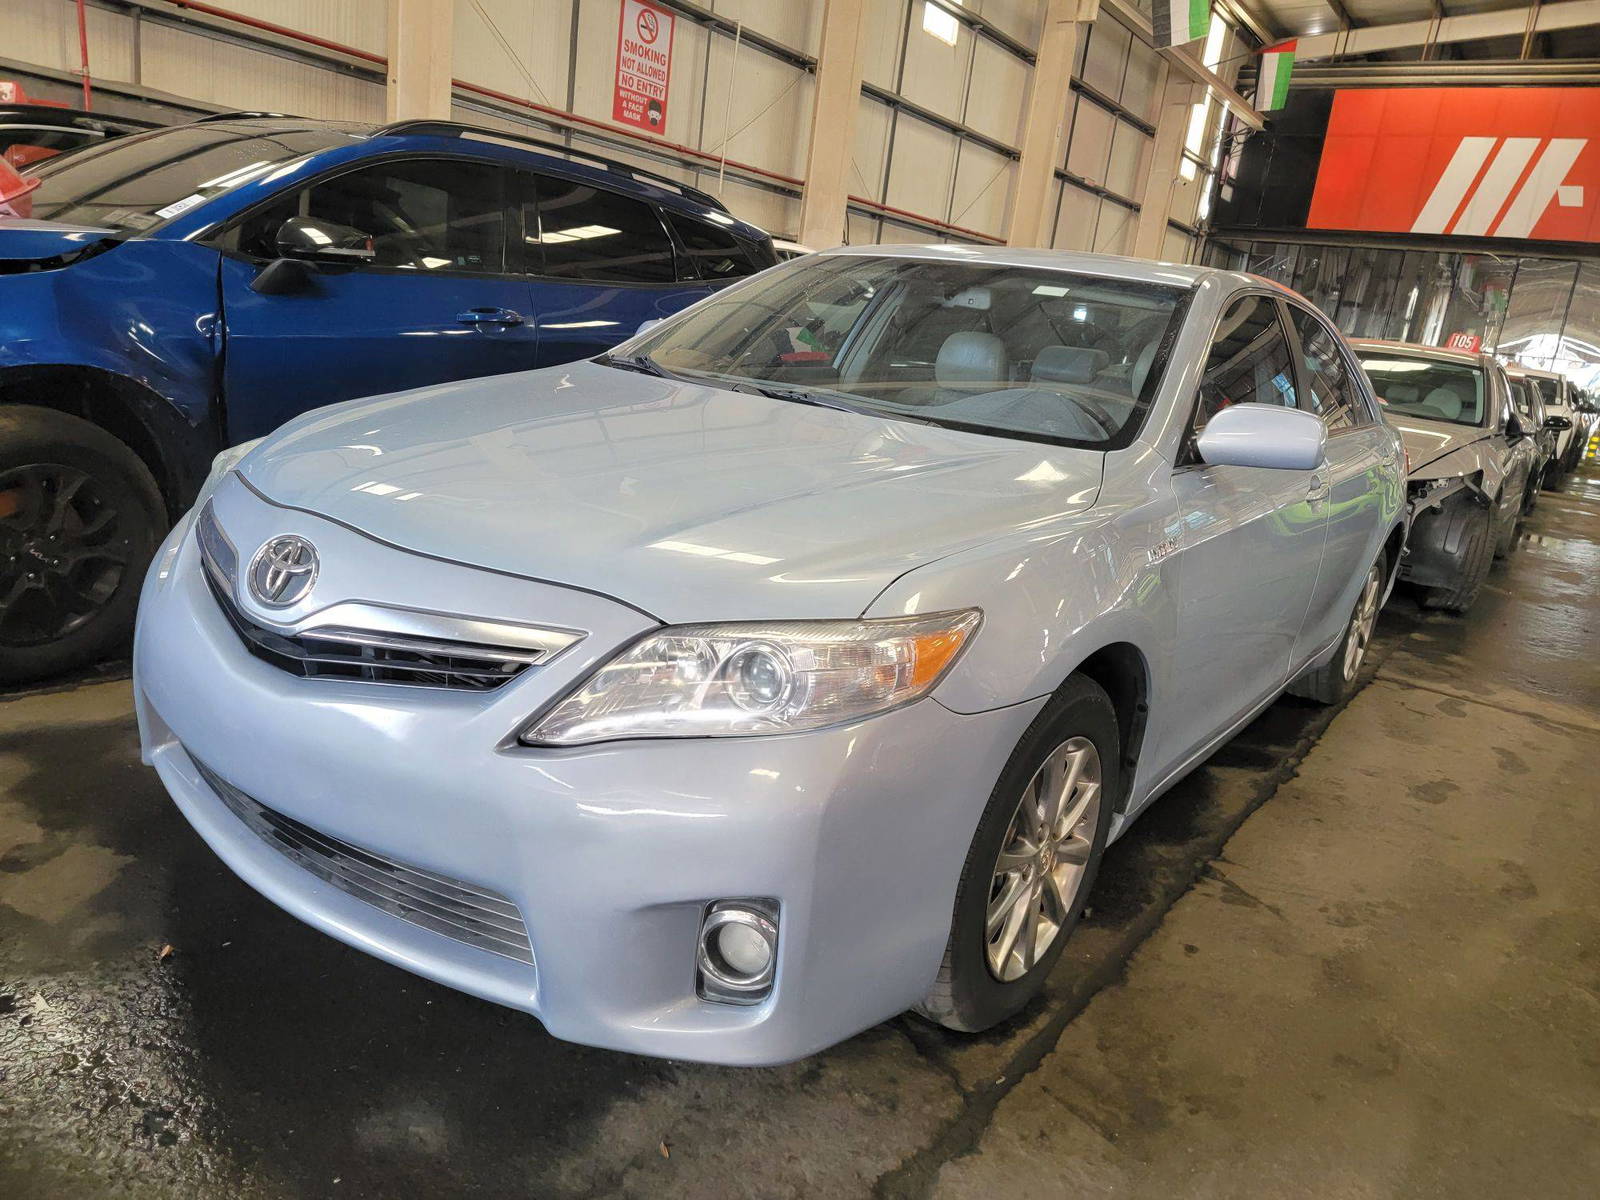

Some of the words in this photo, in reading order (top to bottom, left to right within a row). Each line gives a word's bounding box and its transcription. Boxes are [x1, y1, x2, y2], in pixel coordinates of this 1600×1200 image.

[624, 39, 666, 66] SMOKING
[621, 55, 635, 71] NOT
[636, 62, 665, 82] ALLOWED
[621, 73, 634, 88] NO
[636, 79, 664, 98] ENTRY
[620, 89, 648, 105] WITHOUT
[628, 101, 644, 113] FACE
[1453, 335, 1474, 349] 105
